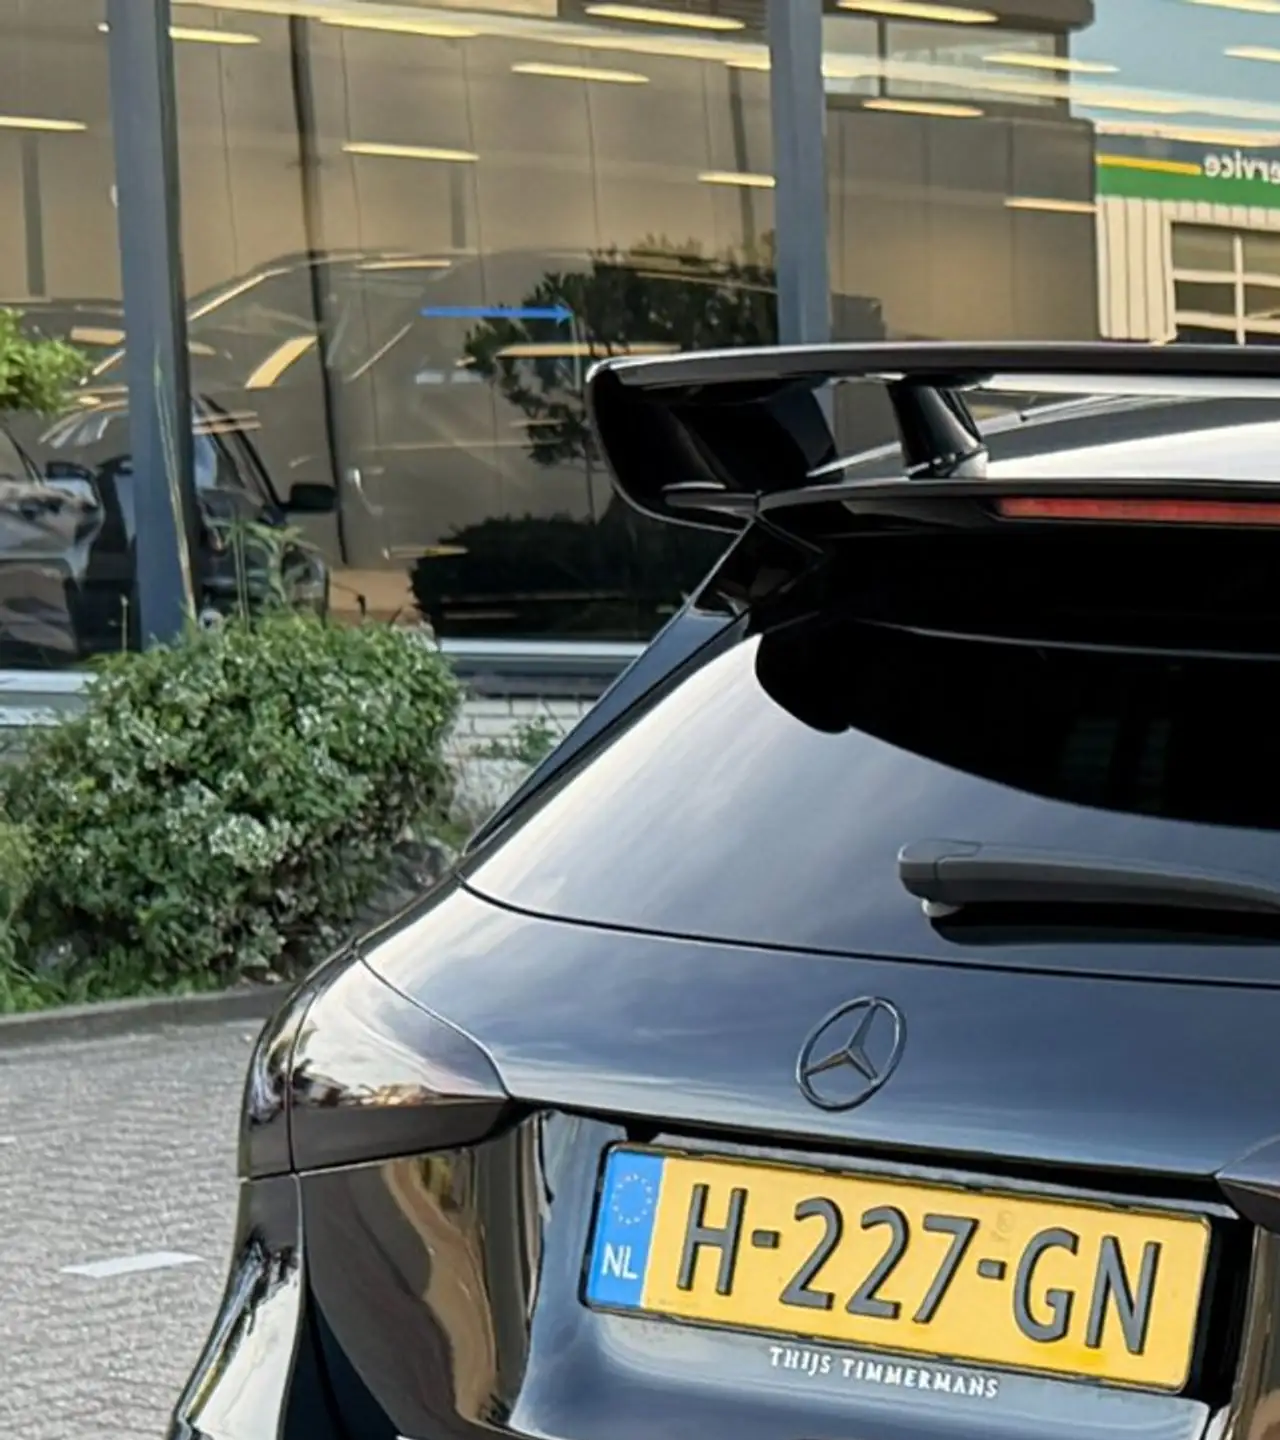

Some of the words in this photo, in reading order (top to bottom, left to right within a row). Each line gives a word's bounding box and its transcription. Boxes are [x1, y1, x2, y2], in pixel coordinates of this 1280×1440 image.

[602, 1243, 638, 1280] NL
[676, 1182, 1162, 1356] H-227-GN
[769, 1345, 832, 1378] THIJS
[841, 1357, 999, 1399] TIMMERMANS
